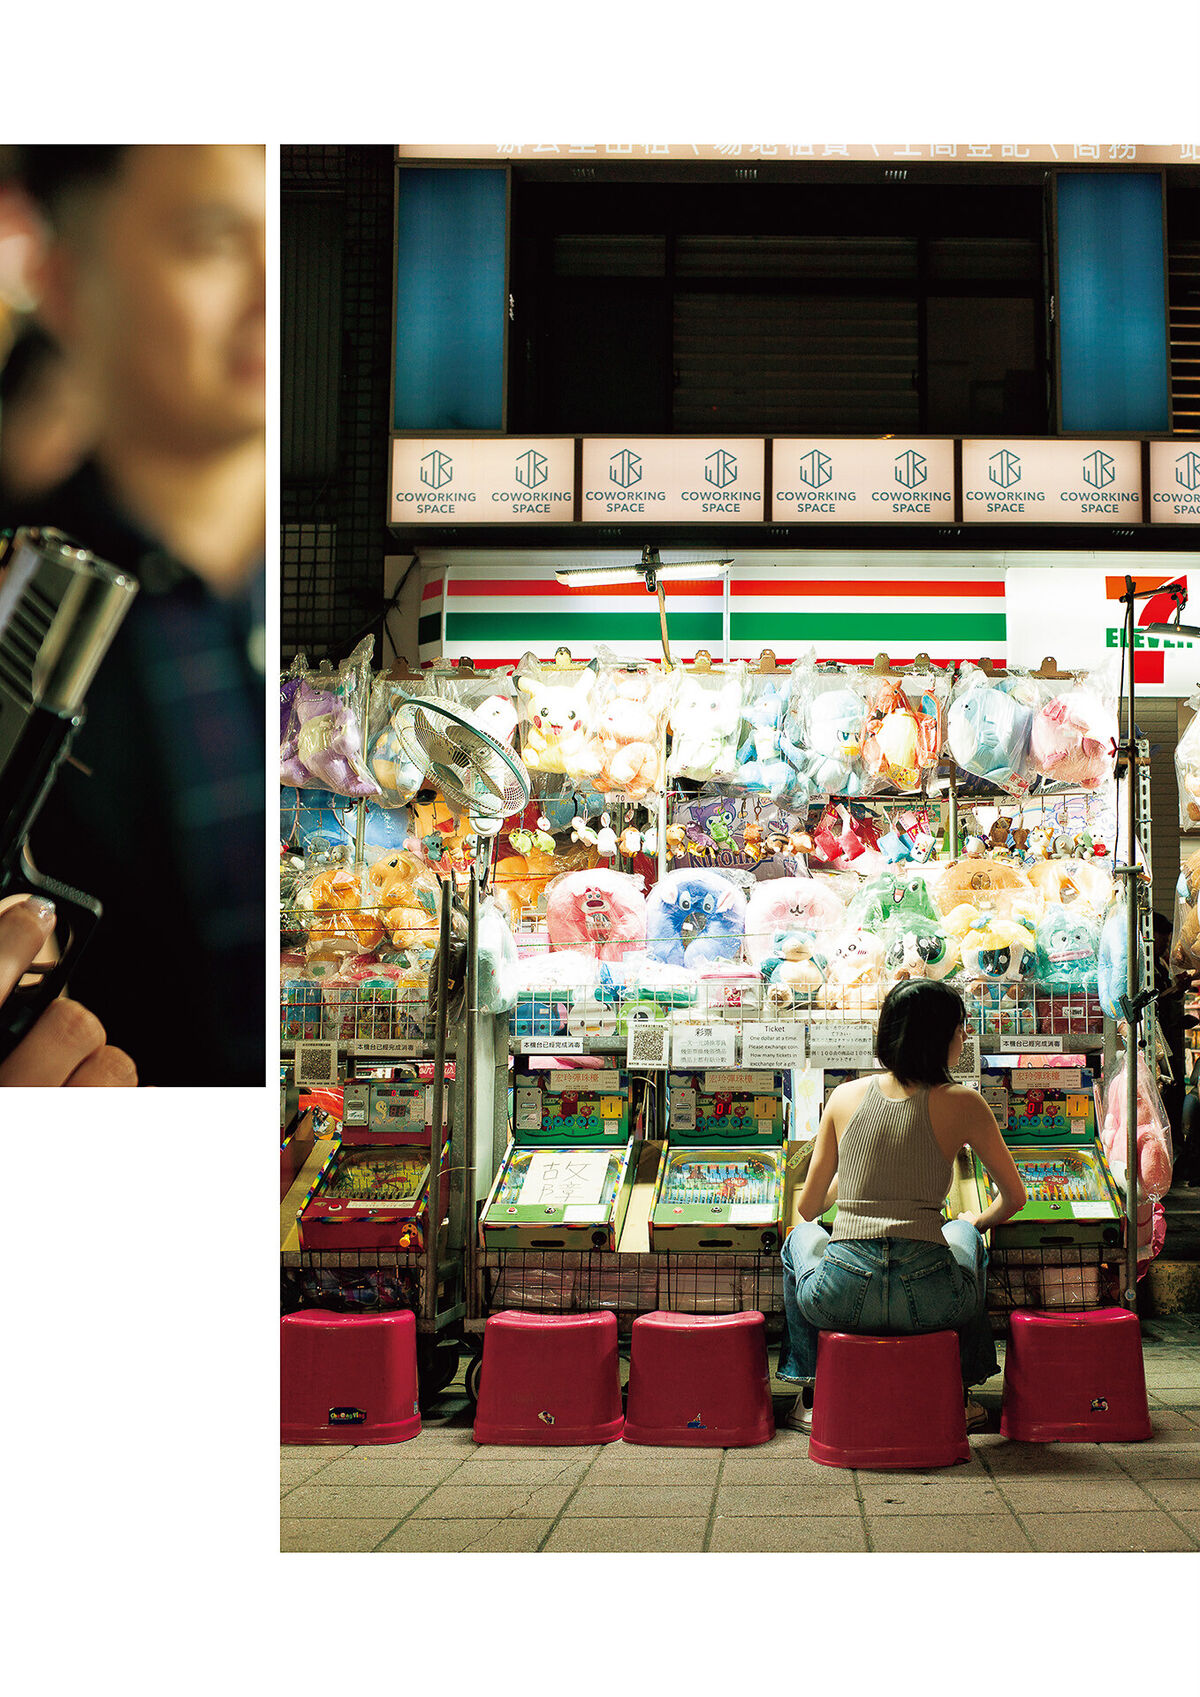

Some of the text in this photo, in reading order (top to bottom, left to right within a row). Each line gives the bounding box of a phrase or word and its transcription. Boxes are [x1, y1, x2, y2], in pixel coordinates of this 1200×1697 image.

[395, 492, 476, 502] COWORKING
[491, 491, 572, 502] COWORKING
[585, 491, 666, 501] COWORKING
[681, 491, 761, 501] COWORKING
[776, 491, 857, 501] COWORKING
[871, 491, 952, 501] COWORKING
[965, 491, 1046, 501] COWORKING
[1060, 491, 1140, 502] COWORKING
[416, 504, 455, 514] SPACE
[512, 503, 551, 514] SPACE
[606, 502, 645, 513] SPACE
[702, 503, 741, 513] SPACE
[797, 503, 836, 513] SPACE
[892, 503, 931, 513] SPACE
[986, 502, 1025, 513] SPACE
[1081, 503, 1119, 513] SPACE
[1105, 575, 1188, 684] 7
[765, 1025, 785, 1033] Ticket
[523, 1041, 581, 1049] 本機台已經完成消毒
[1002, 1040, 1061, 1048] 本機台已經完成消毒
